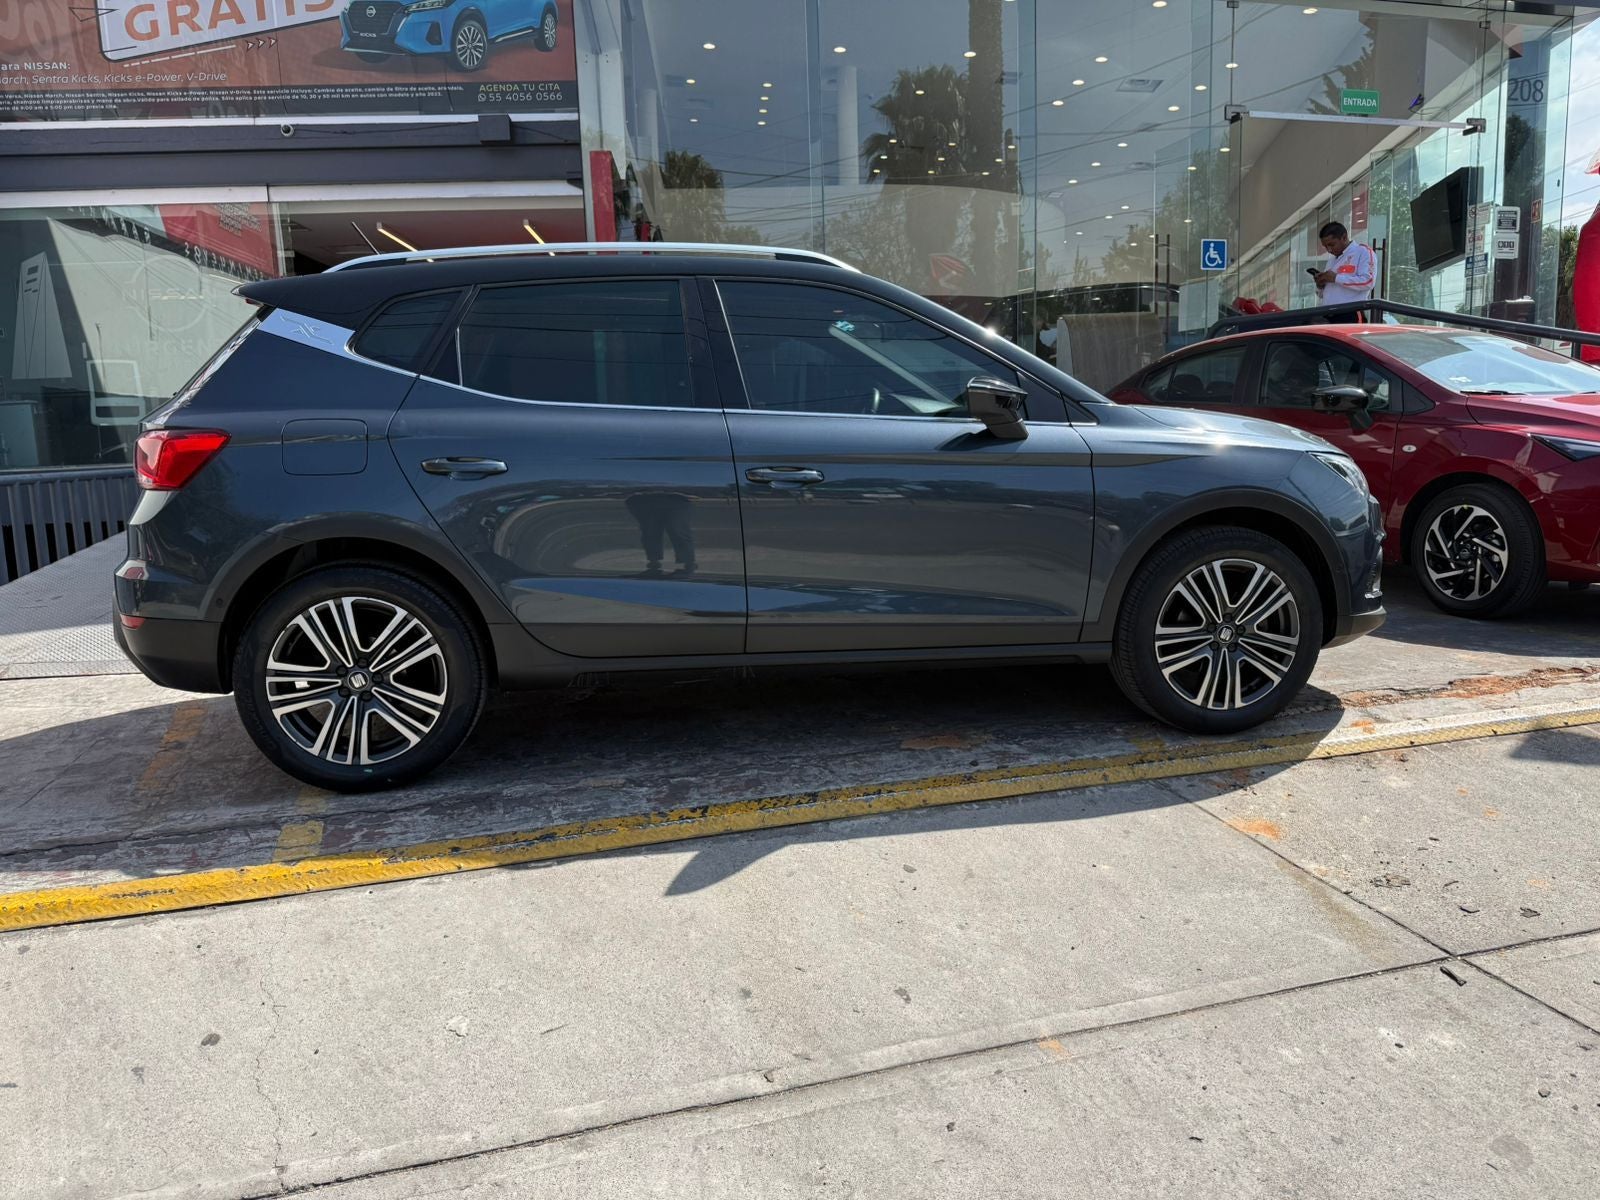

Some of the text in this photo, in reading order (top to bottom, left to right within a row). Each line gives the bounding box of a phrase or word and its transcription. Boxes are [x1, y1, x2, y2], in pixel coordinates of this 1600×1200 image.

[24, 61, 71, 70] NISSAN:
[0, 72, 226, 85] arch, Sentra Kicks, Kicks e-Power, V-Drive
[480, 83, 560, 92] AGENDA TU CITA
[1507, 79, 1544, 102] 208
[489, 91, 563, 101] 55 4056 0566
[1343, 97, 1377, 107] ENTRADA
